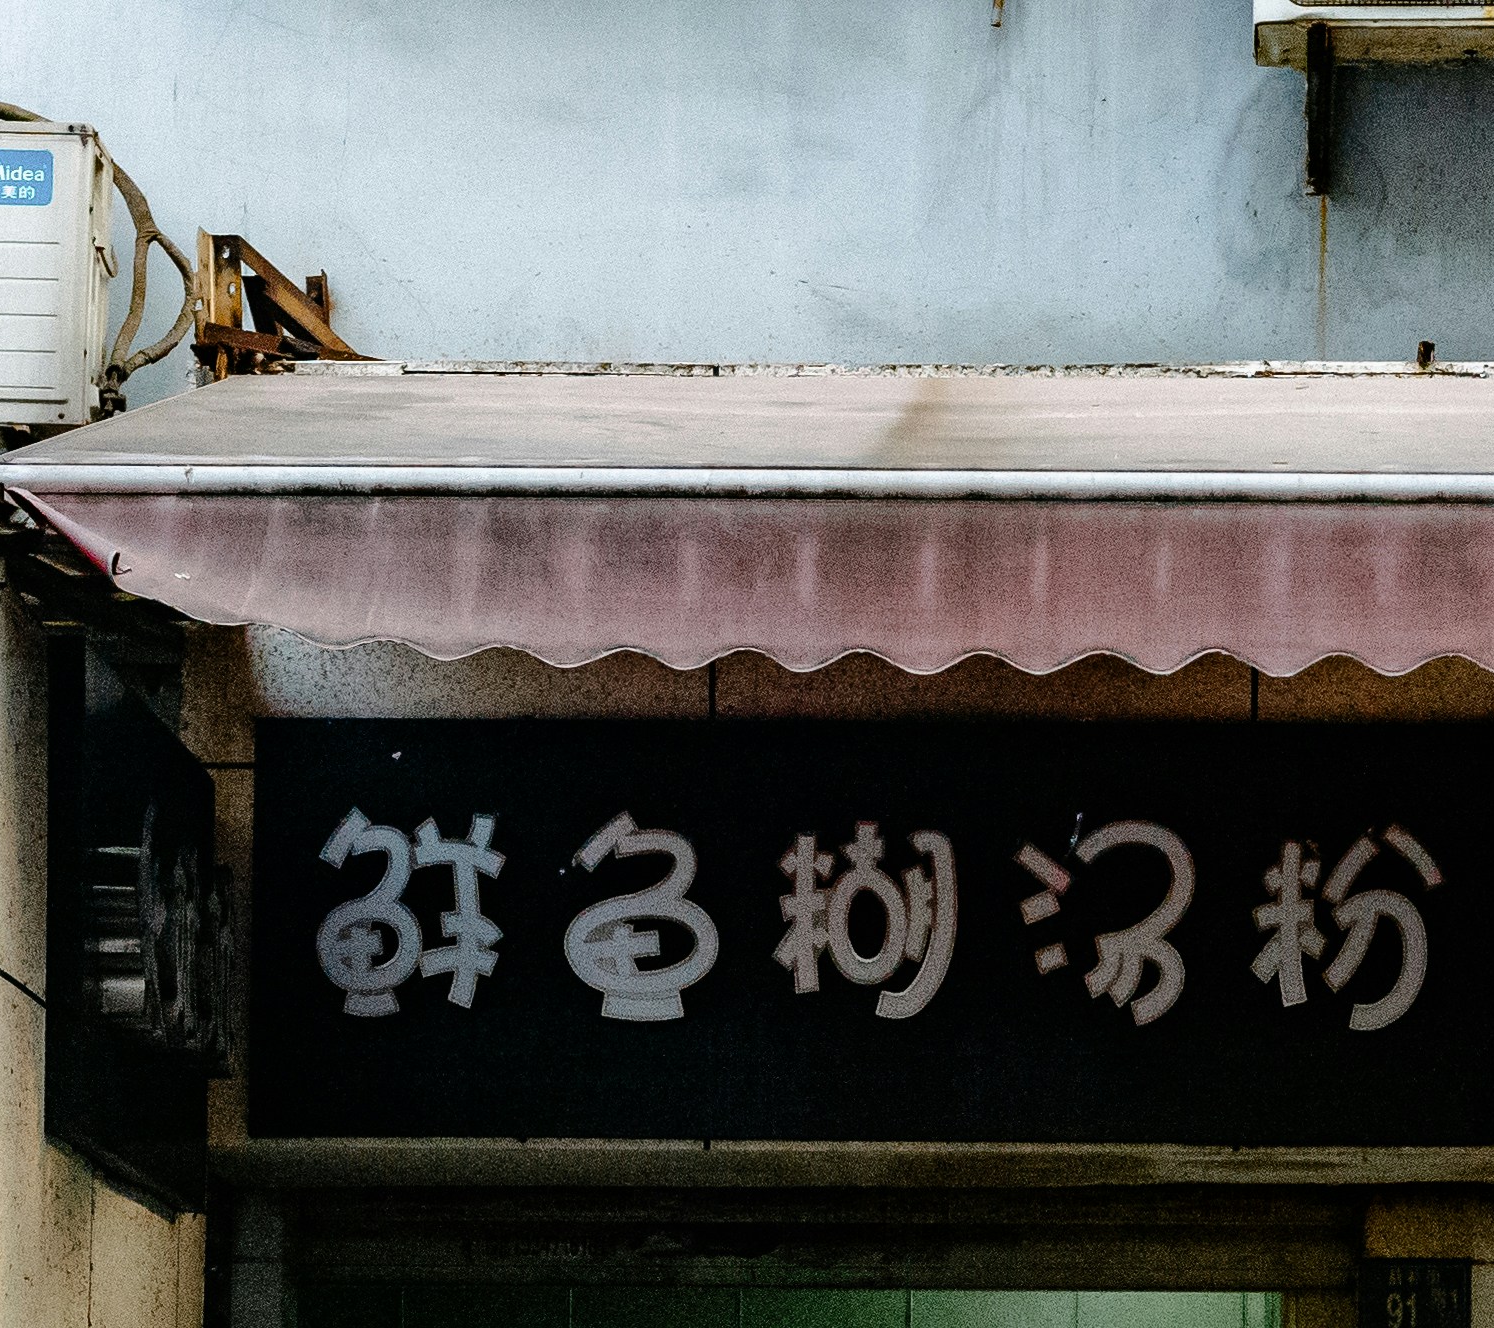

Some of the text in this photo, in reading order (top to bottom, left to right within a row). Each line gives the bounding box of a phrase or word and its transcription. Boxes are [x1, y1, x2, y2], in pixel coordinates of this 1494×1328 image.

[0, 185, 36, 200] 美的
[315, 805, 1444, 1032] 鲜鱼糊汤粉
